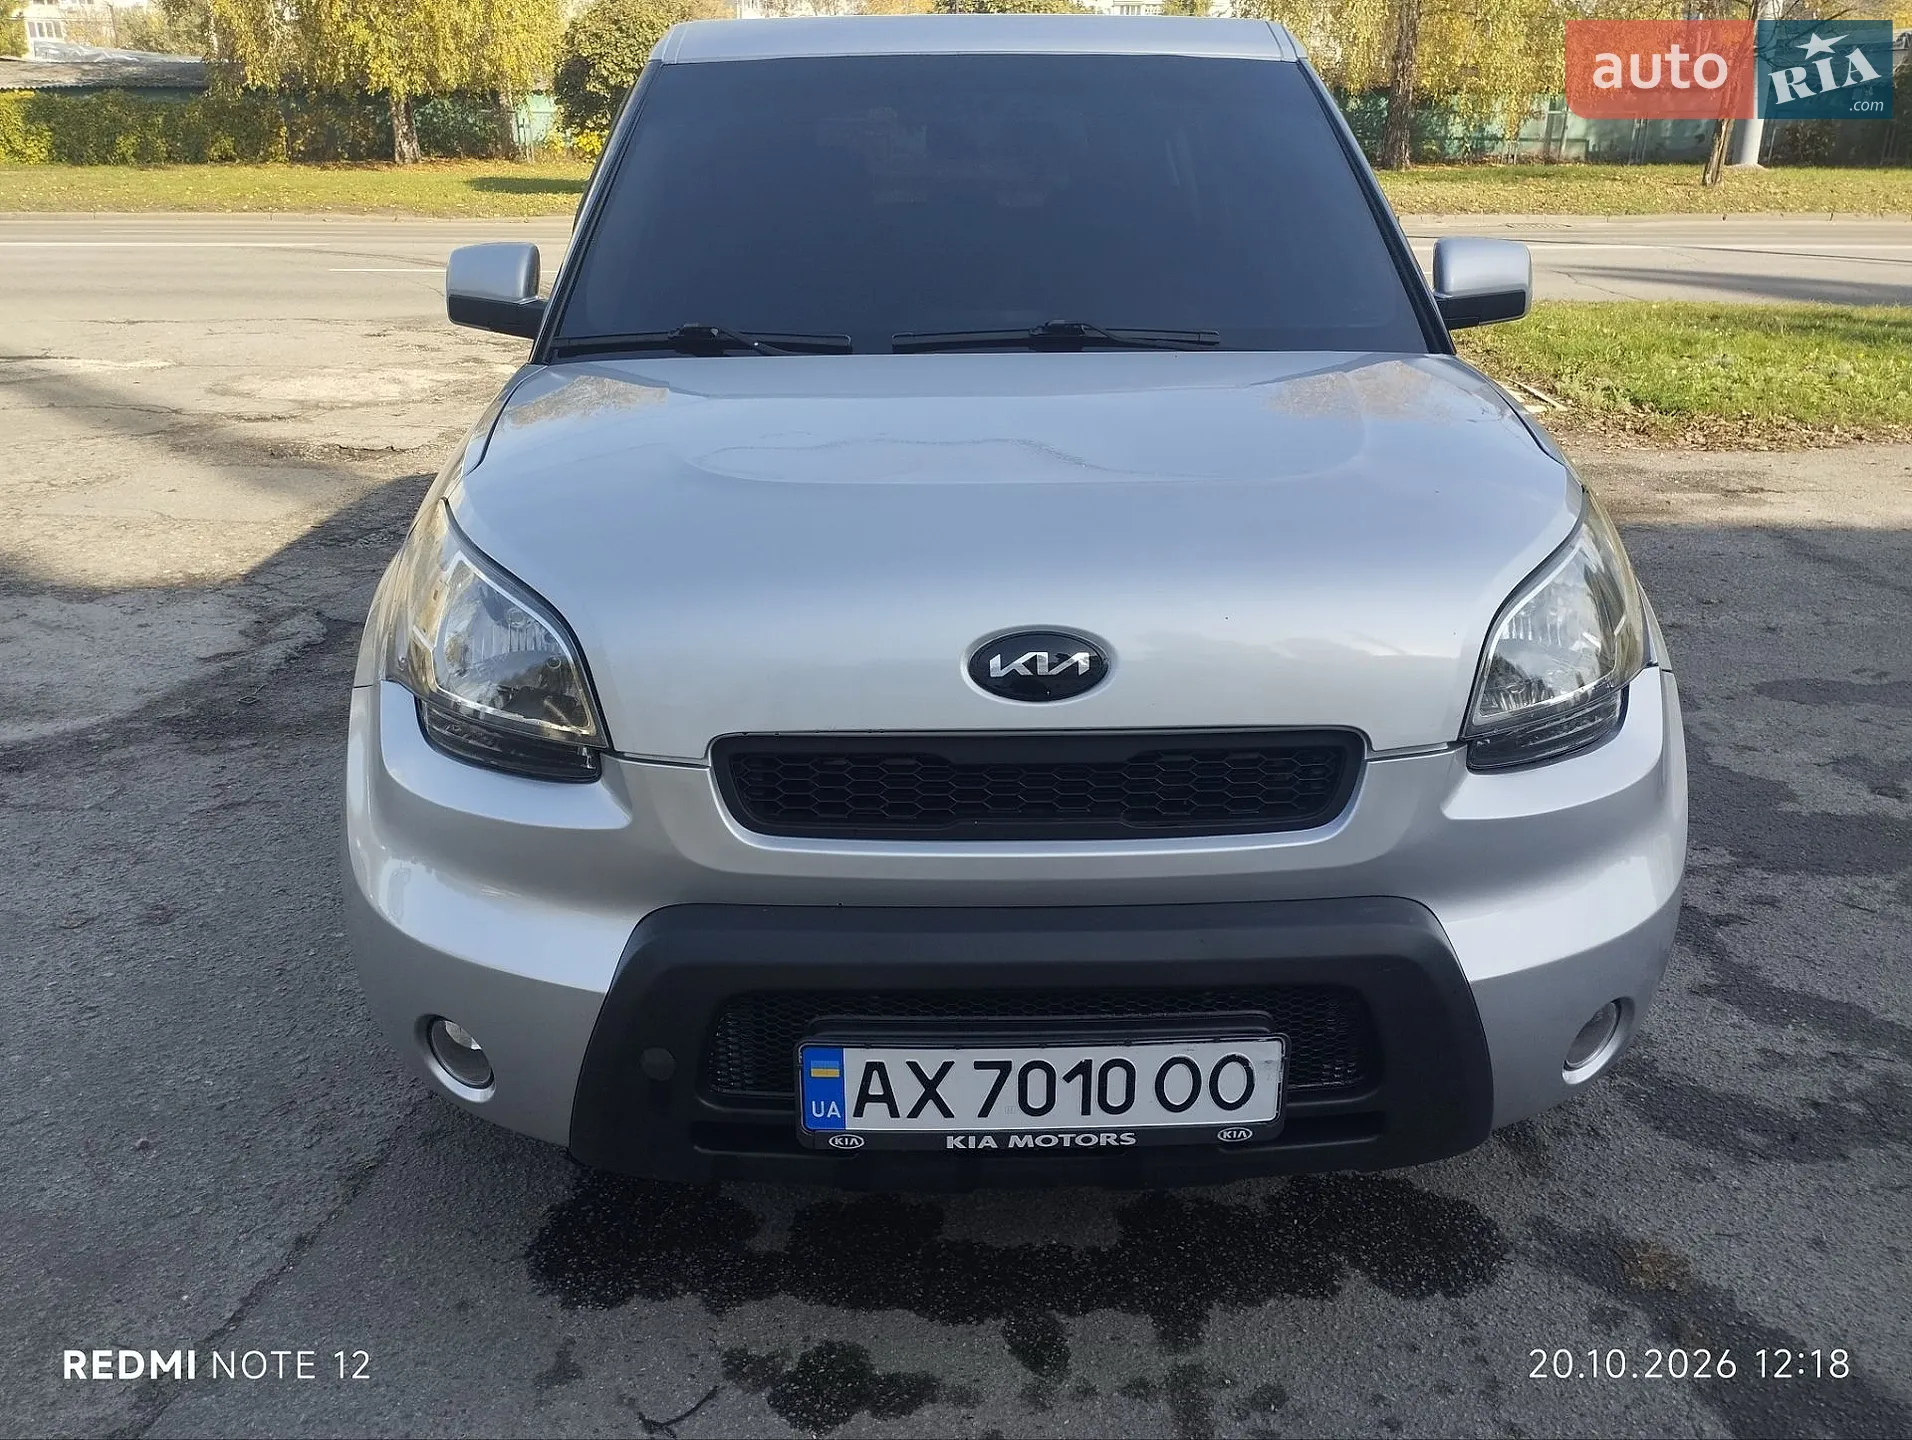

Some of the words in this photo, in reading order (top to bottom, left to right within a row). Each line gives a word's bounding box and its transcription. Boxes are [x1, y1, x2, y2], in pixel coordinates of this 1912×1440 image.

[989, 651, 1090, 677] KIA
[852, 1060, 956, 1119] AX
[973, 1058, 1137, 1118] 7010
[1154, 1053, 1256, 1114] OO
[811, 1100, 842, 1119] UA
[834, 1136, 860, 1147] KIA
[945, 1133, 998, 1149] KIA
[1008, 1131, 1137, 1149] MOTORS
[1222, 1129, 1248, 1141] KIA
